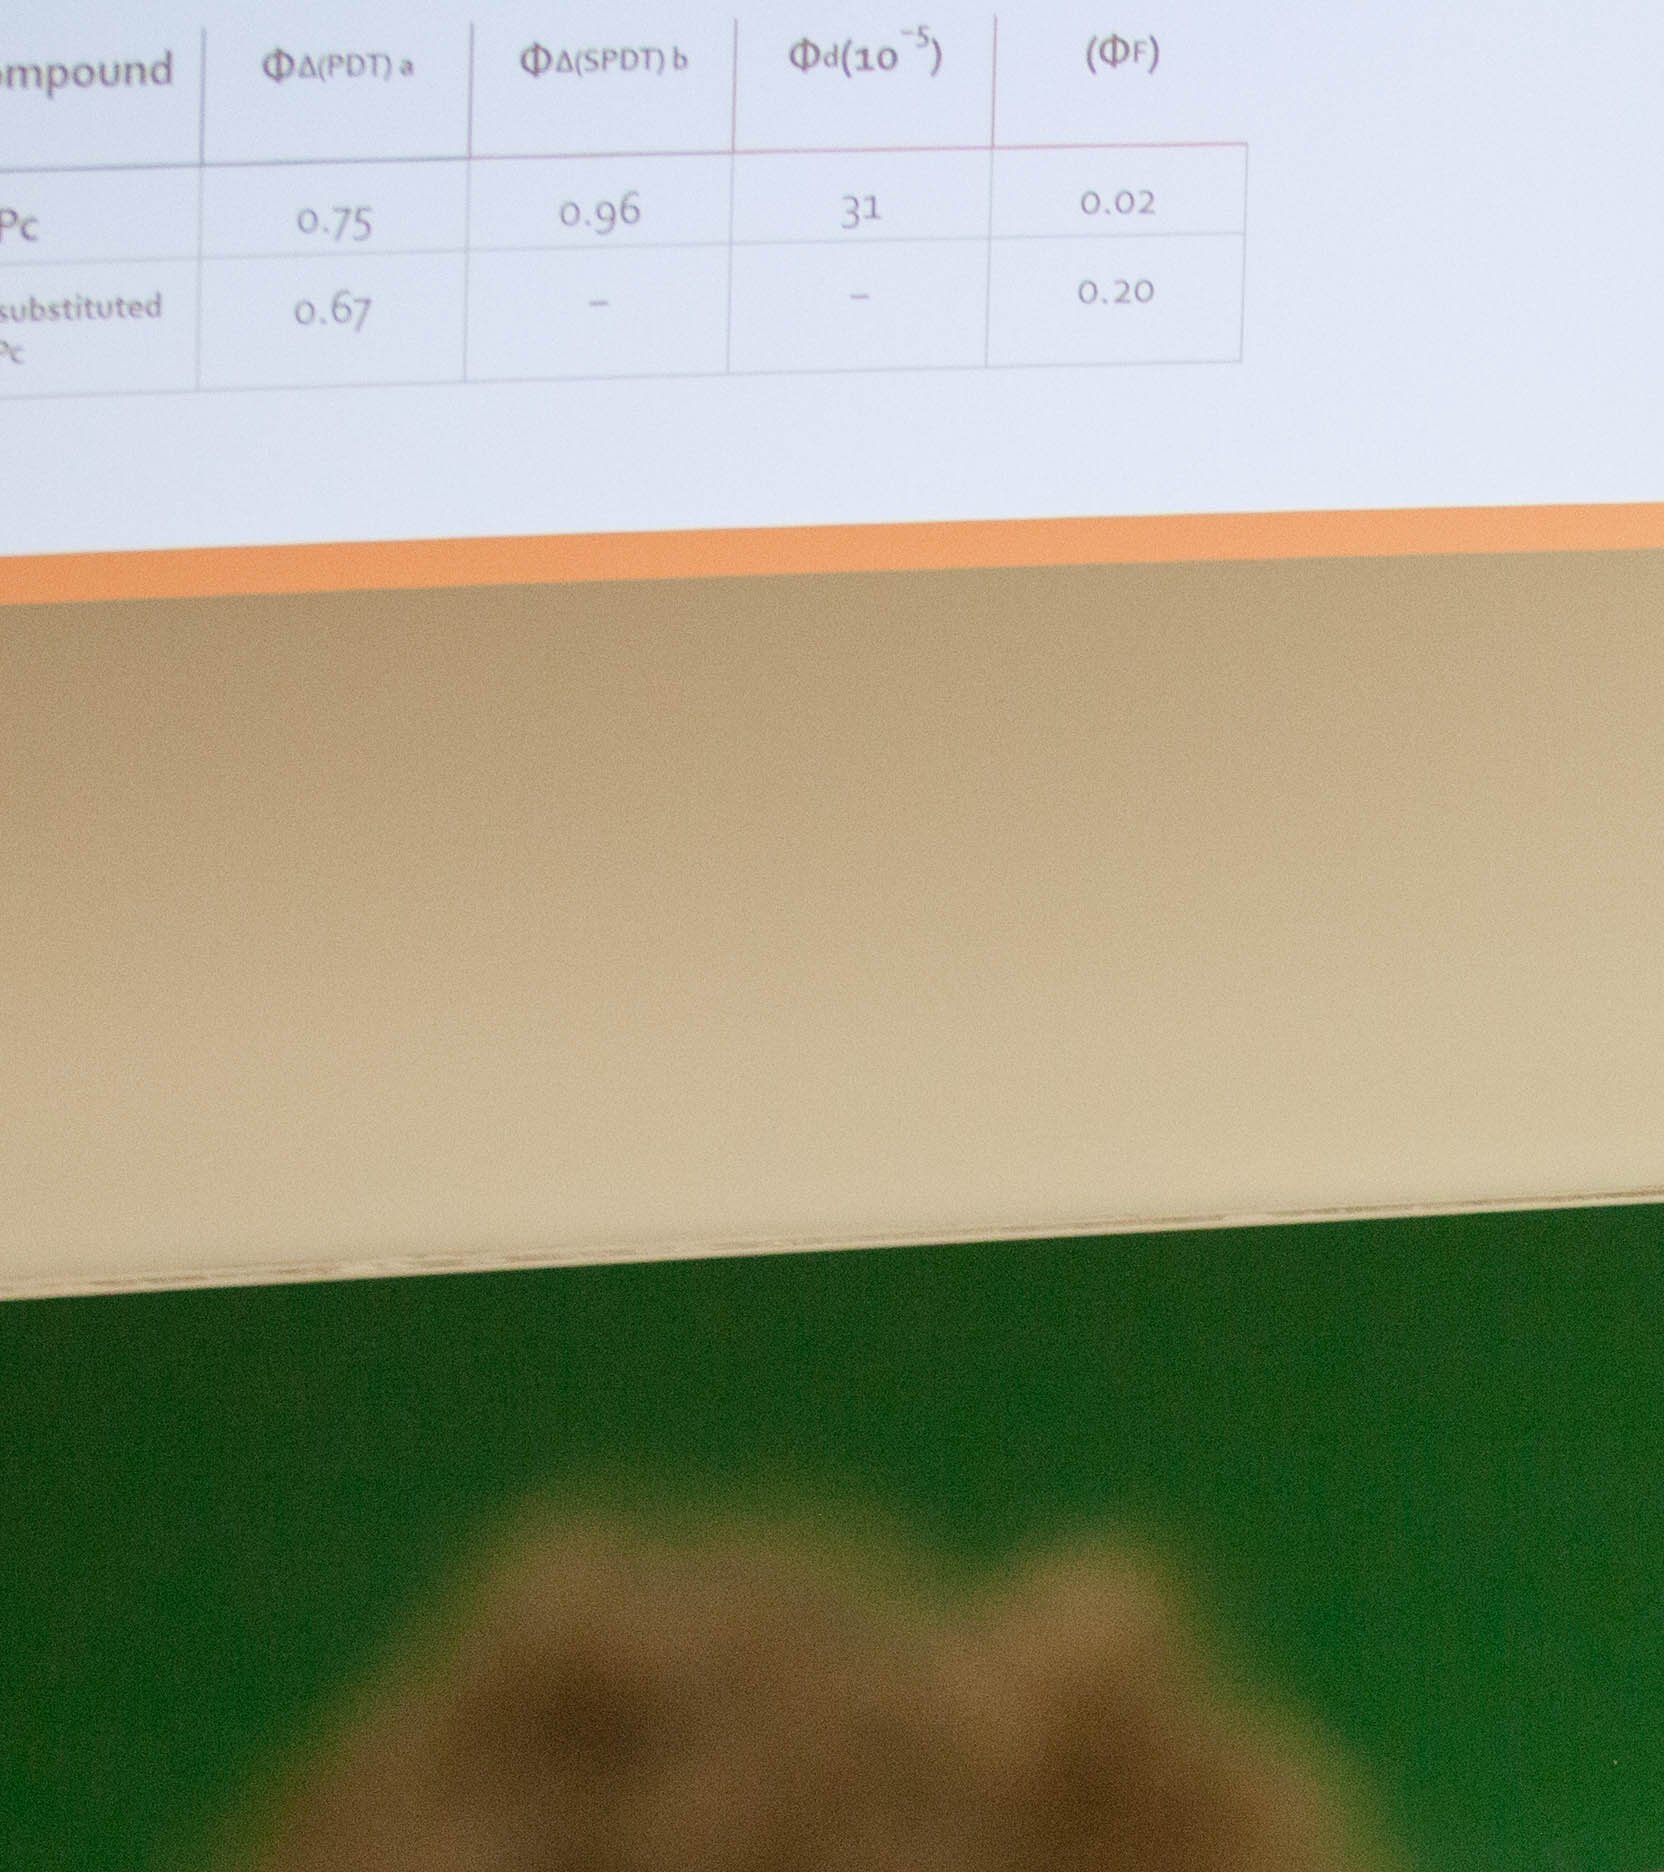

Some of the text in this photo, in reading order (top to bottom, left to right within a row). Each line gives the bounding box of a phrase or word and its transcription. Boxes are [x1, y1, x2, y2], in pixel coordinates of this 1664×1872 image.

[0, 49, 173, 100] mpound
[558, 190, 642, 235] 0.96
[841, 194, 881, 229] 31
[1079, 189, 1156, 216] 0.02
[296, 205, 373, 242] 0.75
[1077, 278, 1156, 305] 0.20
[293, 289, 373, 332] 0.67
